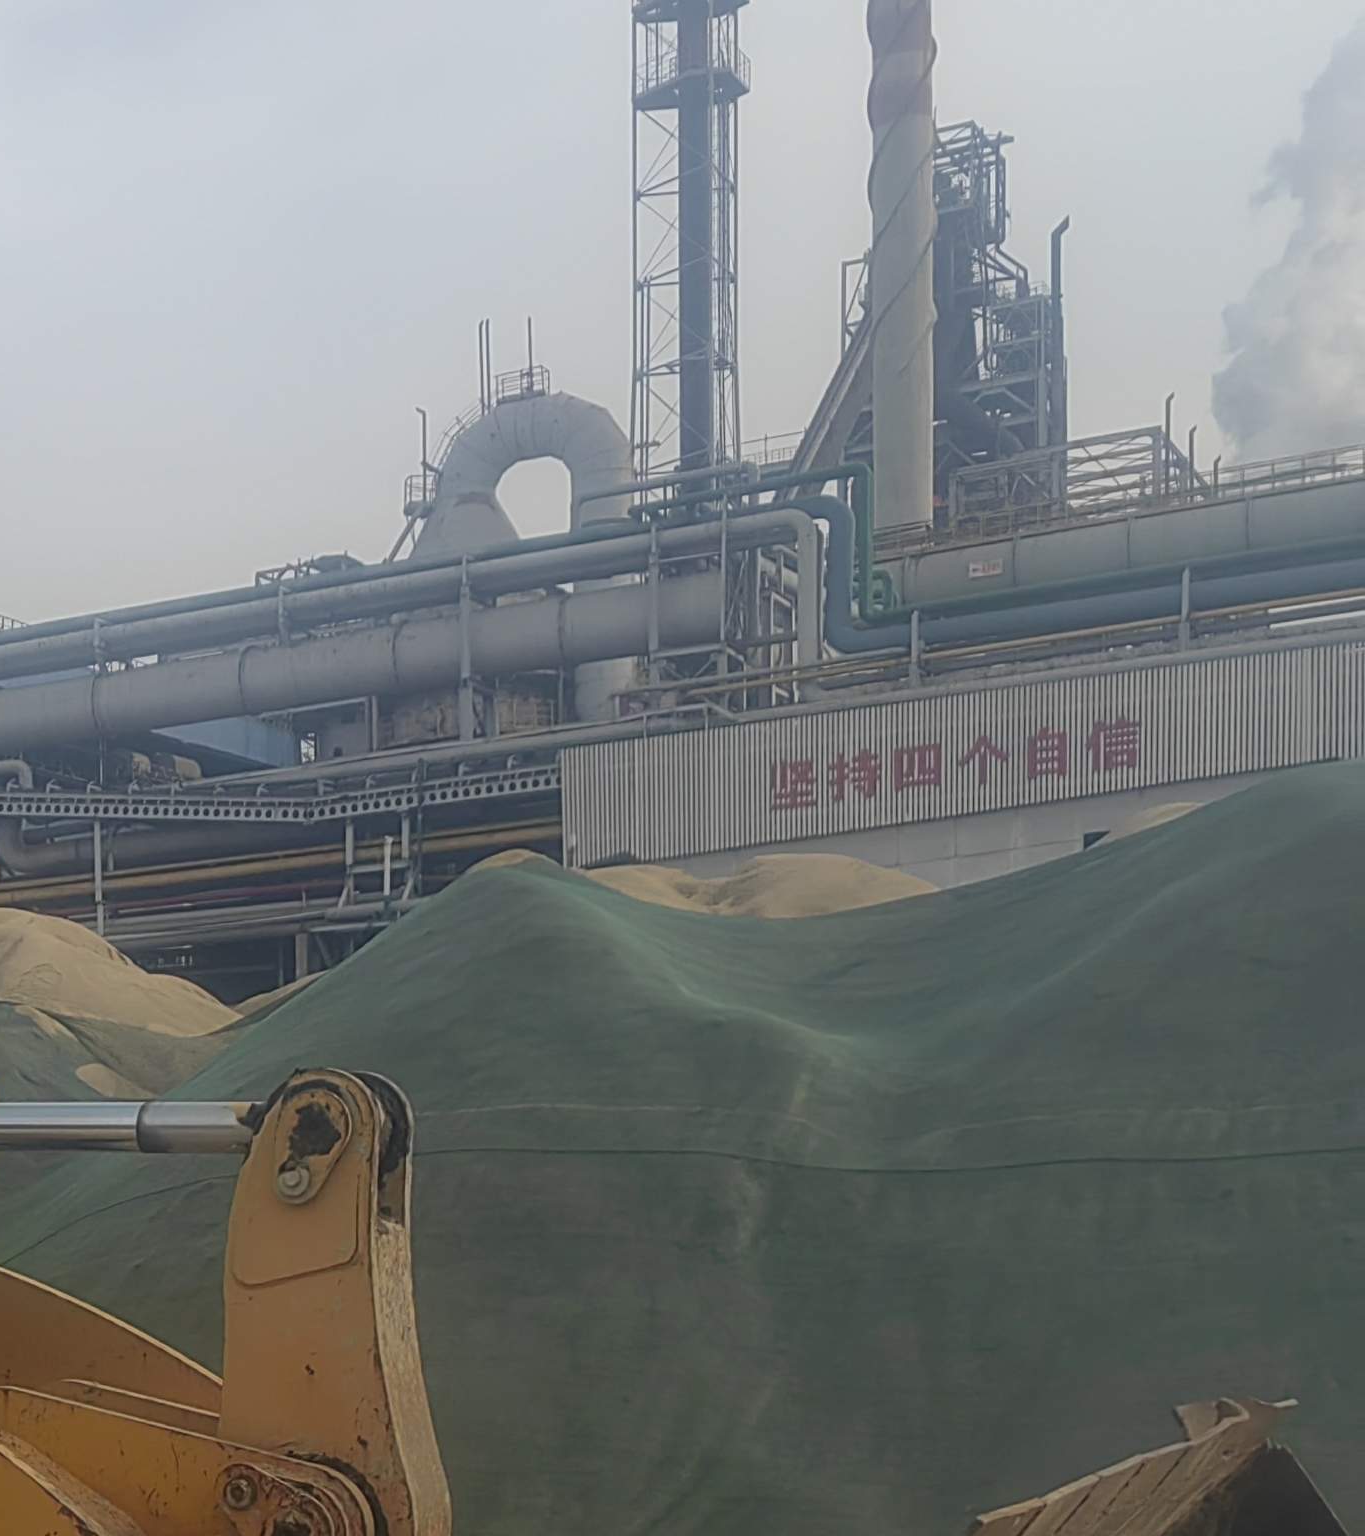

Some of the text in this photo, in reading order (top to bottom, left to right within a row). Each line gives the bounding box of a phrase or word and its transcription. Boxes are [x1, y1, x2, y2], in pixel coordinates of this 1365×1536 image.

[771, 715, 1141, 810] 坚持四个自信
